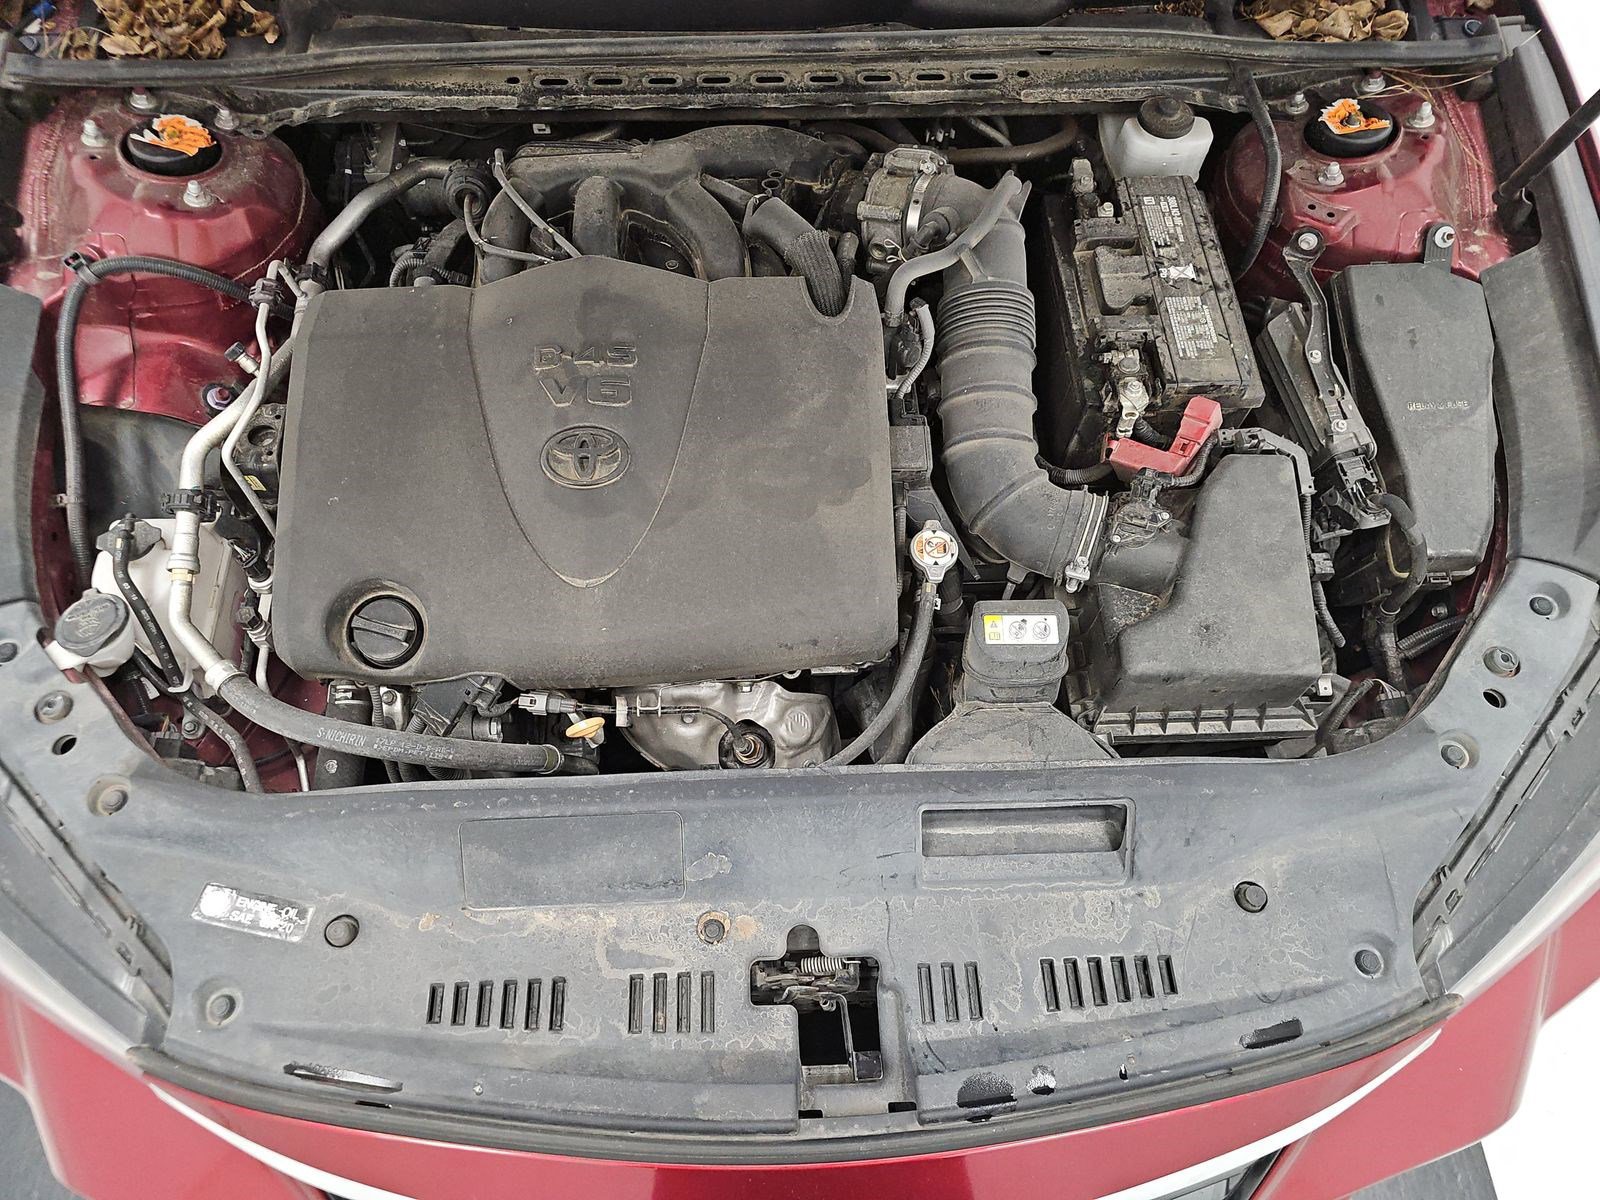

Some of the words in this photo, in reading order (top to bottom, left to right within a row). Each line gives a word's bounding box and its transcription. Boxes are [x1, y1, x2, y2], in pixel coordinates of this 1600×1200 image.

[539, 377, 632, 407] V6
[235, 895, 279, 913] ENGINE
[228, 910, 256, 925] SAE
